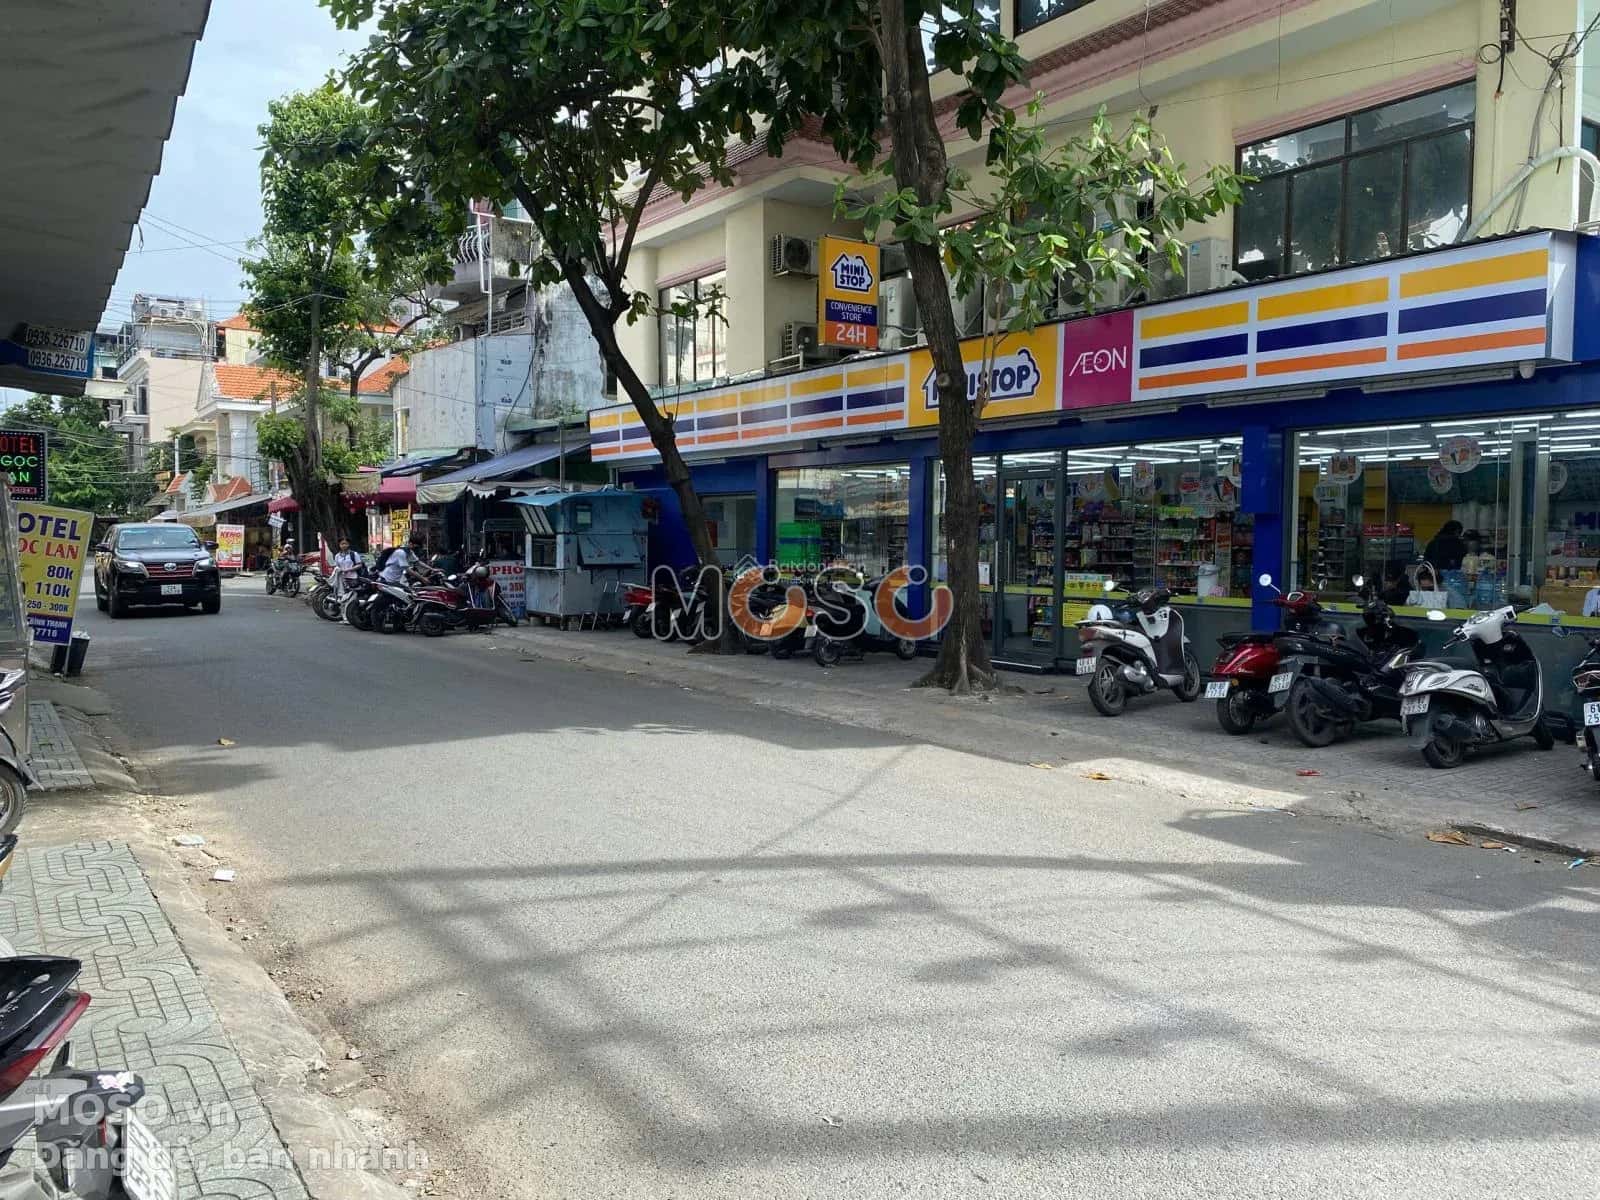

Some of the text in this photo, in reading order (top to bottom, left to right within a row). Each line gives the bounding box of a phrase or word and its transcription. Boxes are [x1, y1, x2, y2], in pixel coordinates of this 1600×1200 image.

[840, 262, 865, 276] MINI
[840, 274, 866, 288] STOP
[830, 301, 873, 315] CONVENIENCE
[841, 312, 863, 322] STORE
[836, 323, 867, 344] 24H
[45, 541, 80, 560] LAN
